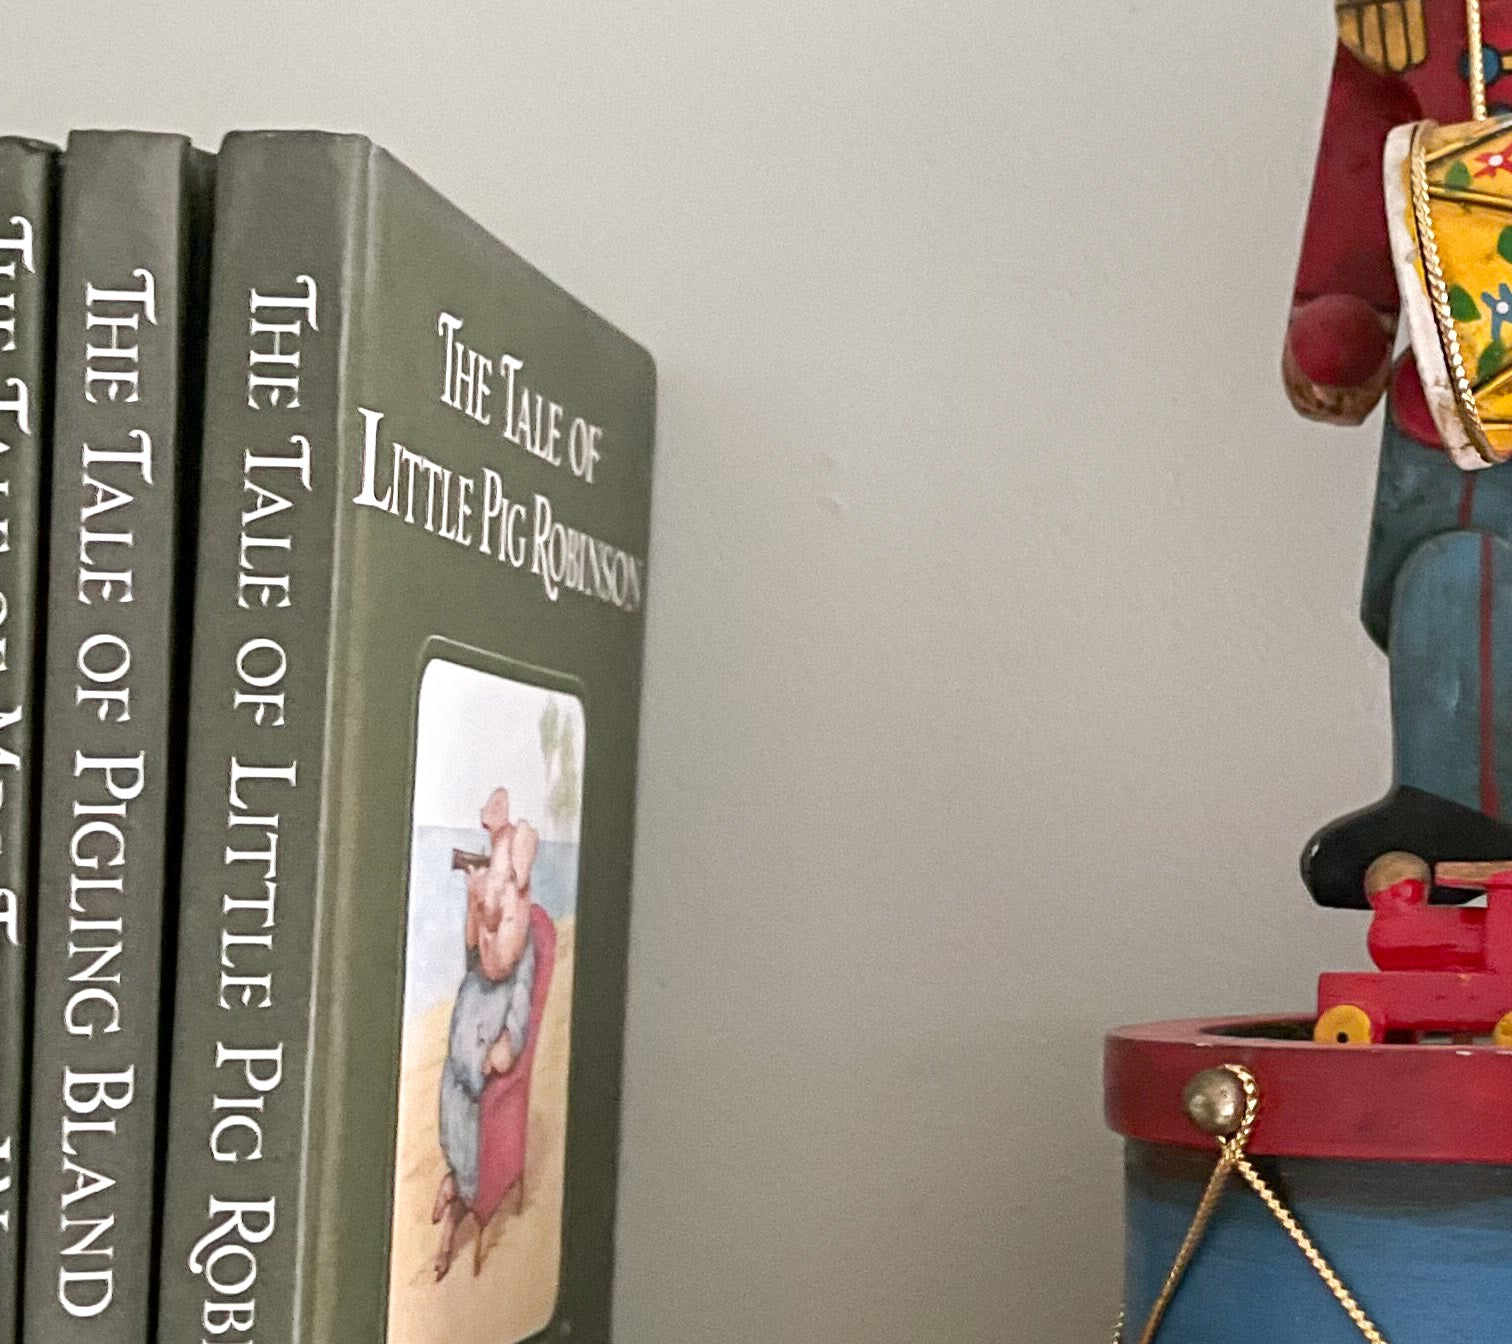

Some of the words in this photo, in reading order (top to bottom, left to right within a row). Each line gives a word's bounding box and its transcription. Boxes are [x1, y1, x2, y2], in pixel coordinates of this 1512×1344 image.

[84, 267, 158, 405] THE
[247, 273, 320, 411] THE
[438, 312, 493, 426] THE
[500, 353, 564, 467] TALE
[568, 417, 604, 484] OF
[77, 429, 154, 606] TALE
[237, 434, 313, 611] TALE
[352, 406, 475, 546] LITTLE
[479, 467, 527, 569] PIG
[530, 493, 642, 612] ROBINSON
[76, 633, 132, 724] OF
[233, 638, 287, 727] OF
[63, 749, 146, 1038] PIGLING
[218, 756, 297, 1011] LITTLE
[208, 1041, 284, 1163] PIG
[58, 1063, 135, 1318] BLAND
